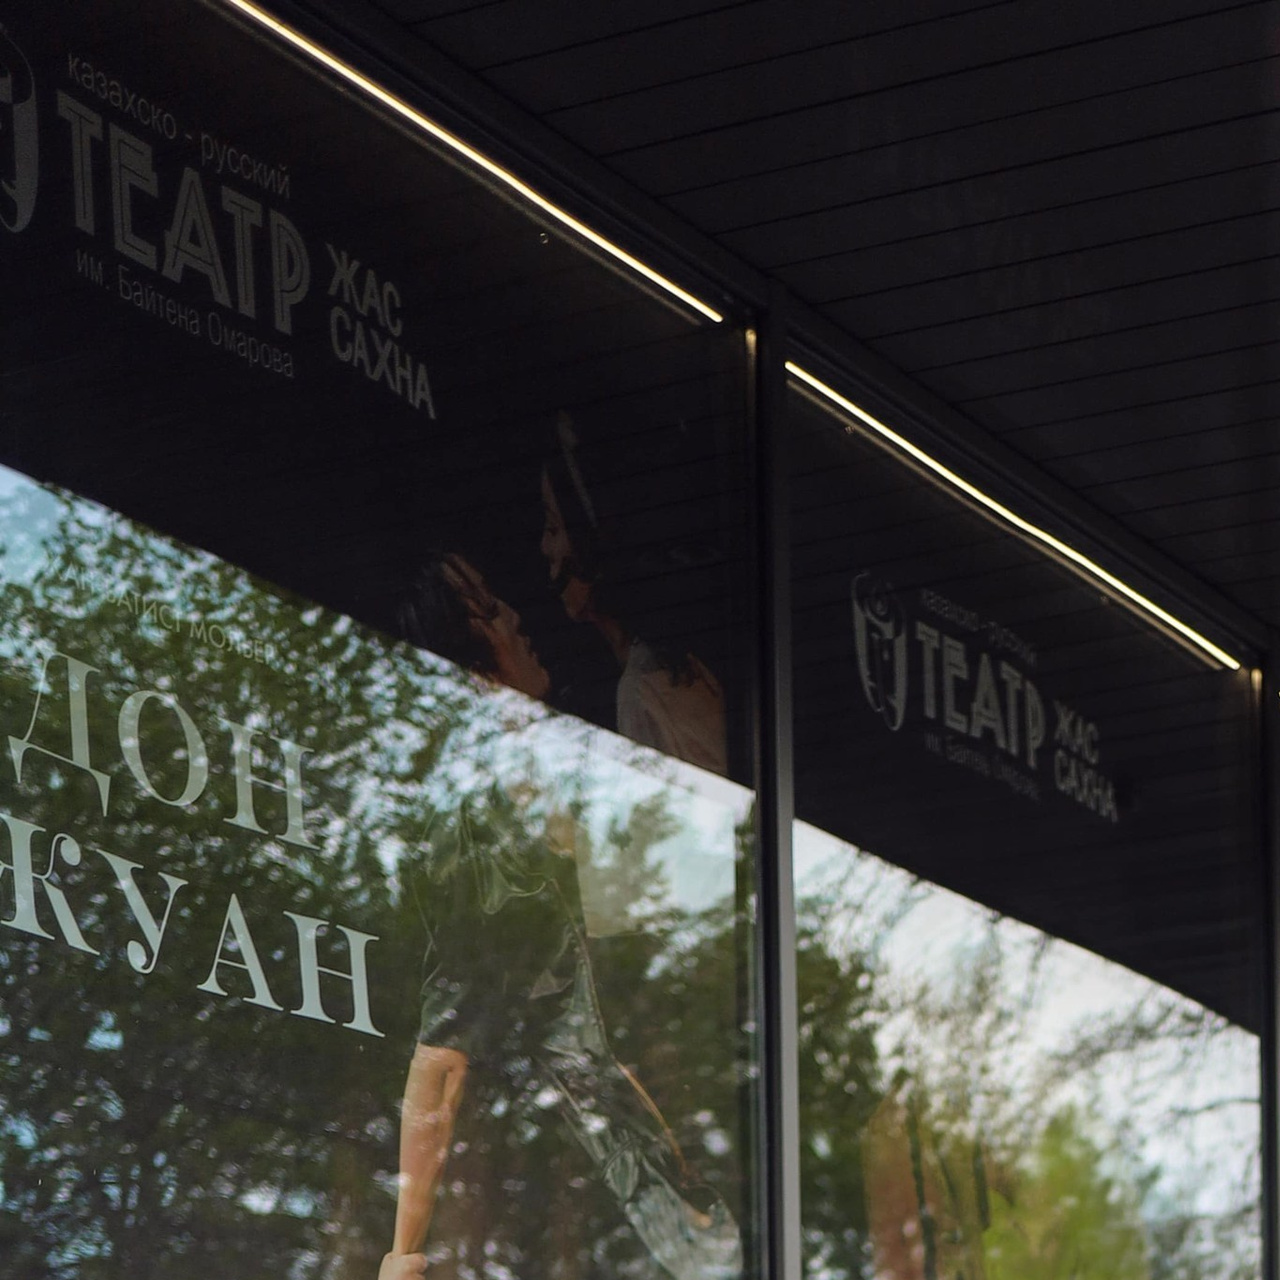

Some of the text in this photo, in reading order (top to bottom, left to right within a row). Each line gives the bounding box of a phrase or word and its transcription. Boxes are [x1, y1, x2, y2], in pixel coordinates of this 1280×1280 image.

[68, 52, 178, 142] казахско
[200, 132, 291, 199] русский
[56, 88, 312, 336] ТЕАТР
[117, 264, 201, 338] Байтена
[206, 311, 295, 379] Омарова
[325, 242, 403, 338] ЖАС
[329, 305, 437, 420] САХНА
[7, 650, 320, 850] ДОН
[915, 620, 1047, 770] ТЕАТР
